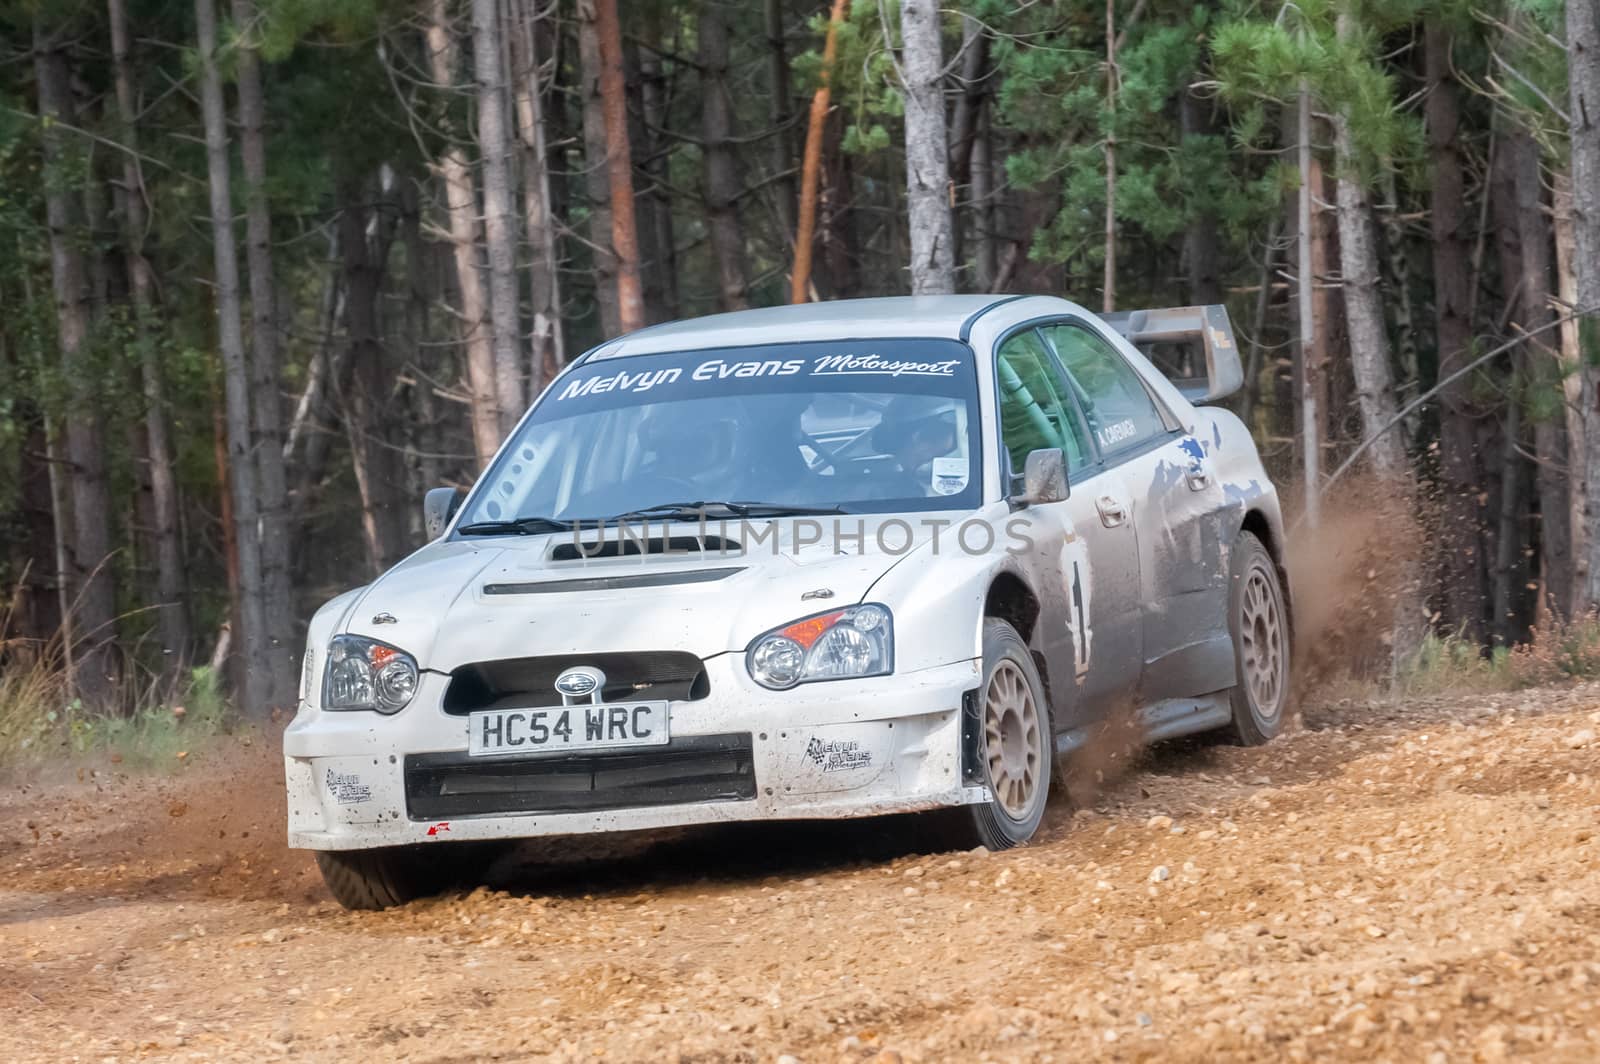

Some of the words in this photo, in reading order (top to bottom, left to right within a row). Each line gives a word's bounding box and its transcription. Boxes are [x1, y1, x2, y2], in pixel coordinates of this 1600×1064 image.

[557, 367, 683, 401] Melvyn
[692, 359, 805, 381] Evans
[810, 354, 961, 377] Motorsport
[482, 710, 573, 748] HC54
[585, 706, 652, 742] WRC
